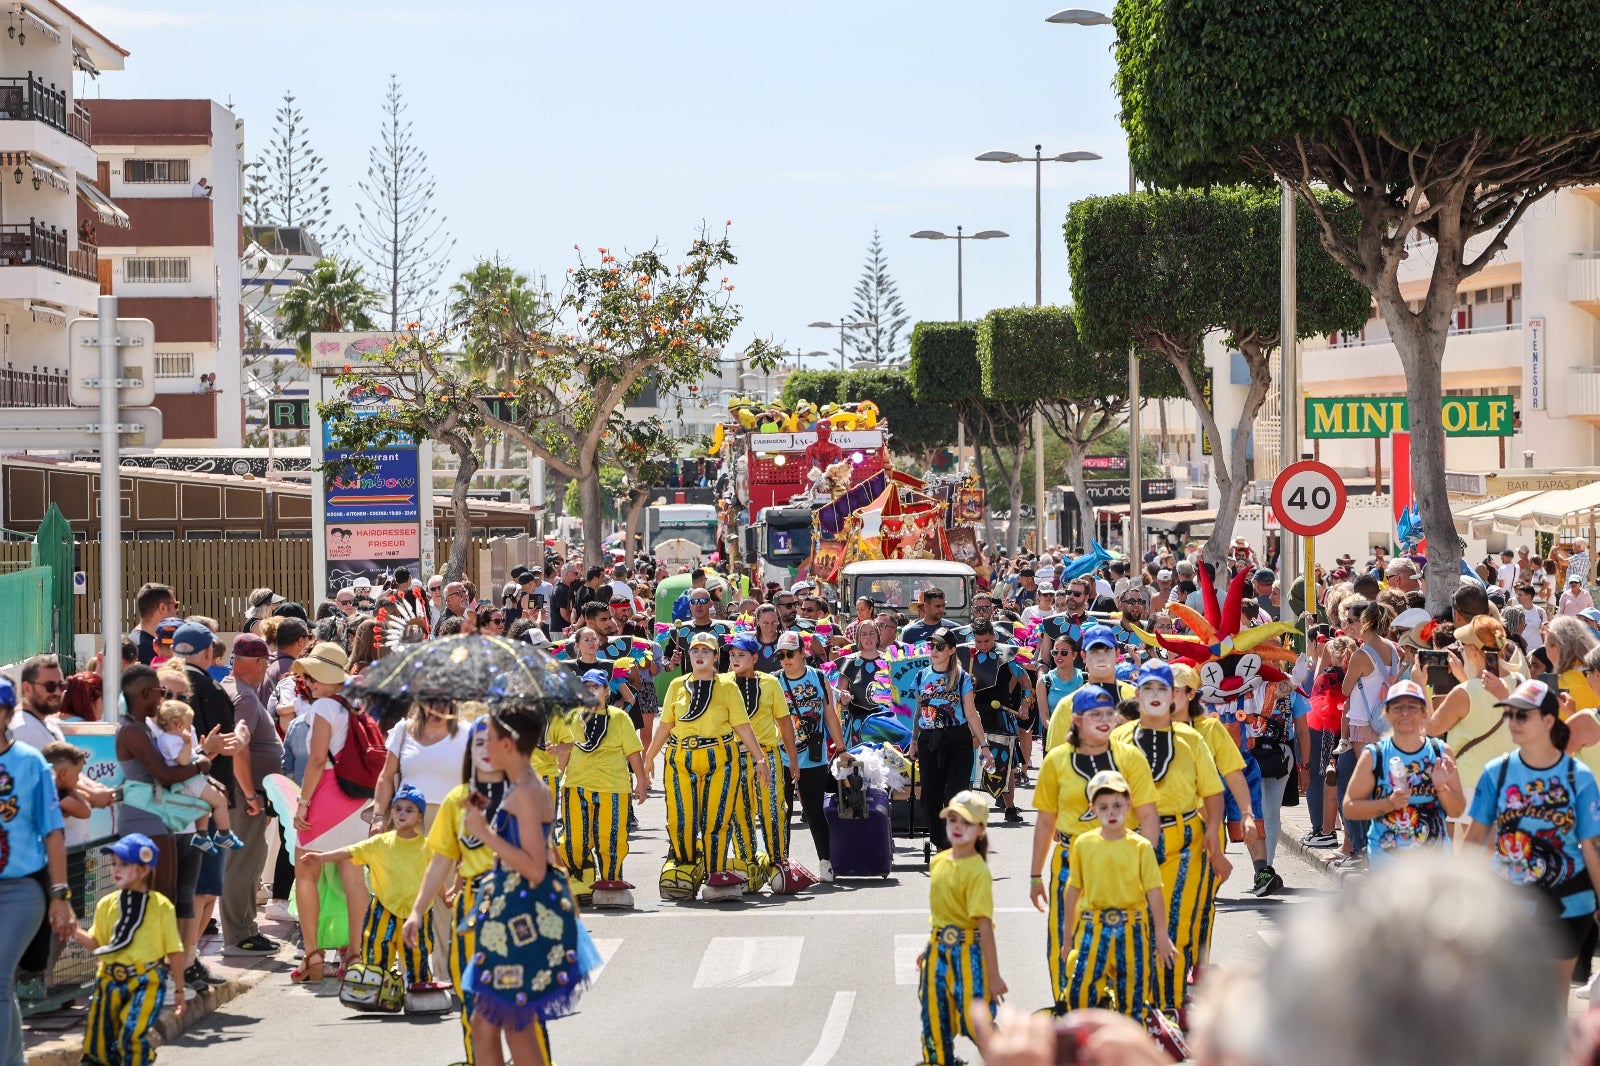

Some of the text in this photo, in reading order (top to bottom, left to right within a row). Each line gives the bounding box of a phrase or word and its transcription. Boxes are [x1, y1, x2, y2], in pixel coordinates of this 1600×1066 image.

[1440, 401, 1507, 431] OLF
[1086, 484, 1131, 497] mundo
[1507, 480, 1529, 491] BAR
[1536, 479, 1571, 491] TAPAS
[1287, 486, 1331, 510] 40
[356, 528, 417, 537] HAIRDRESSER
[368, 540, 406, 548] FRISEUR
[778, 536, 785, 549] 1
[893, 659, 931, 681] BATUC
[87, 762, 117, 781] City
